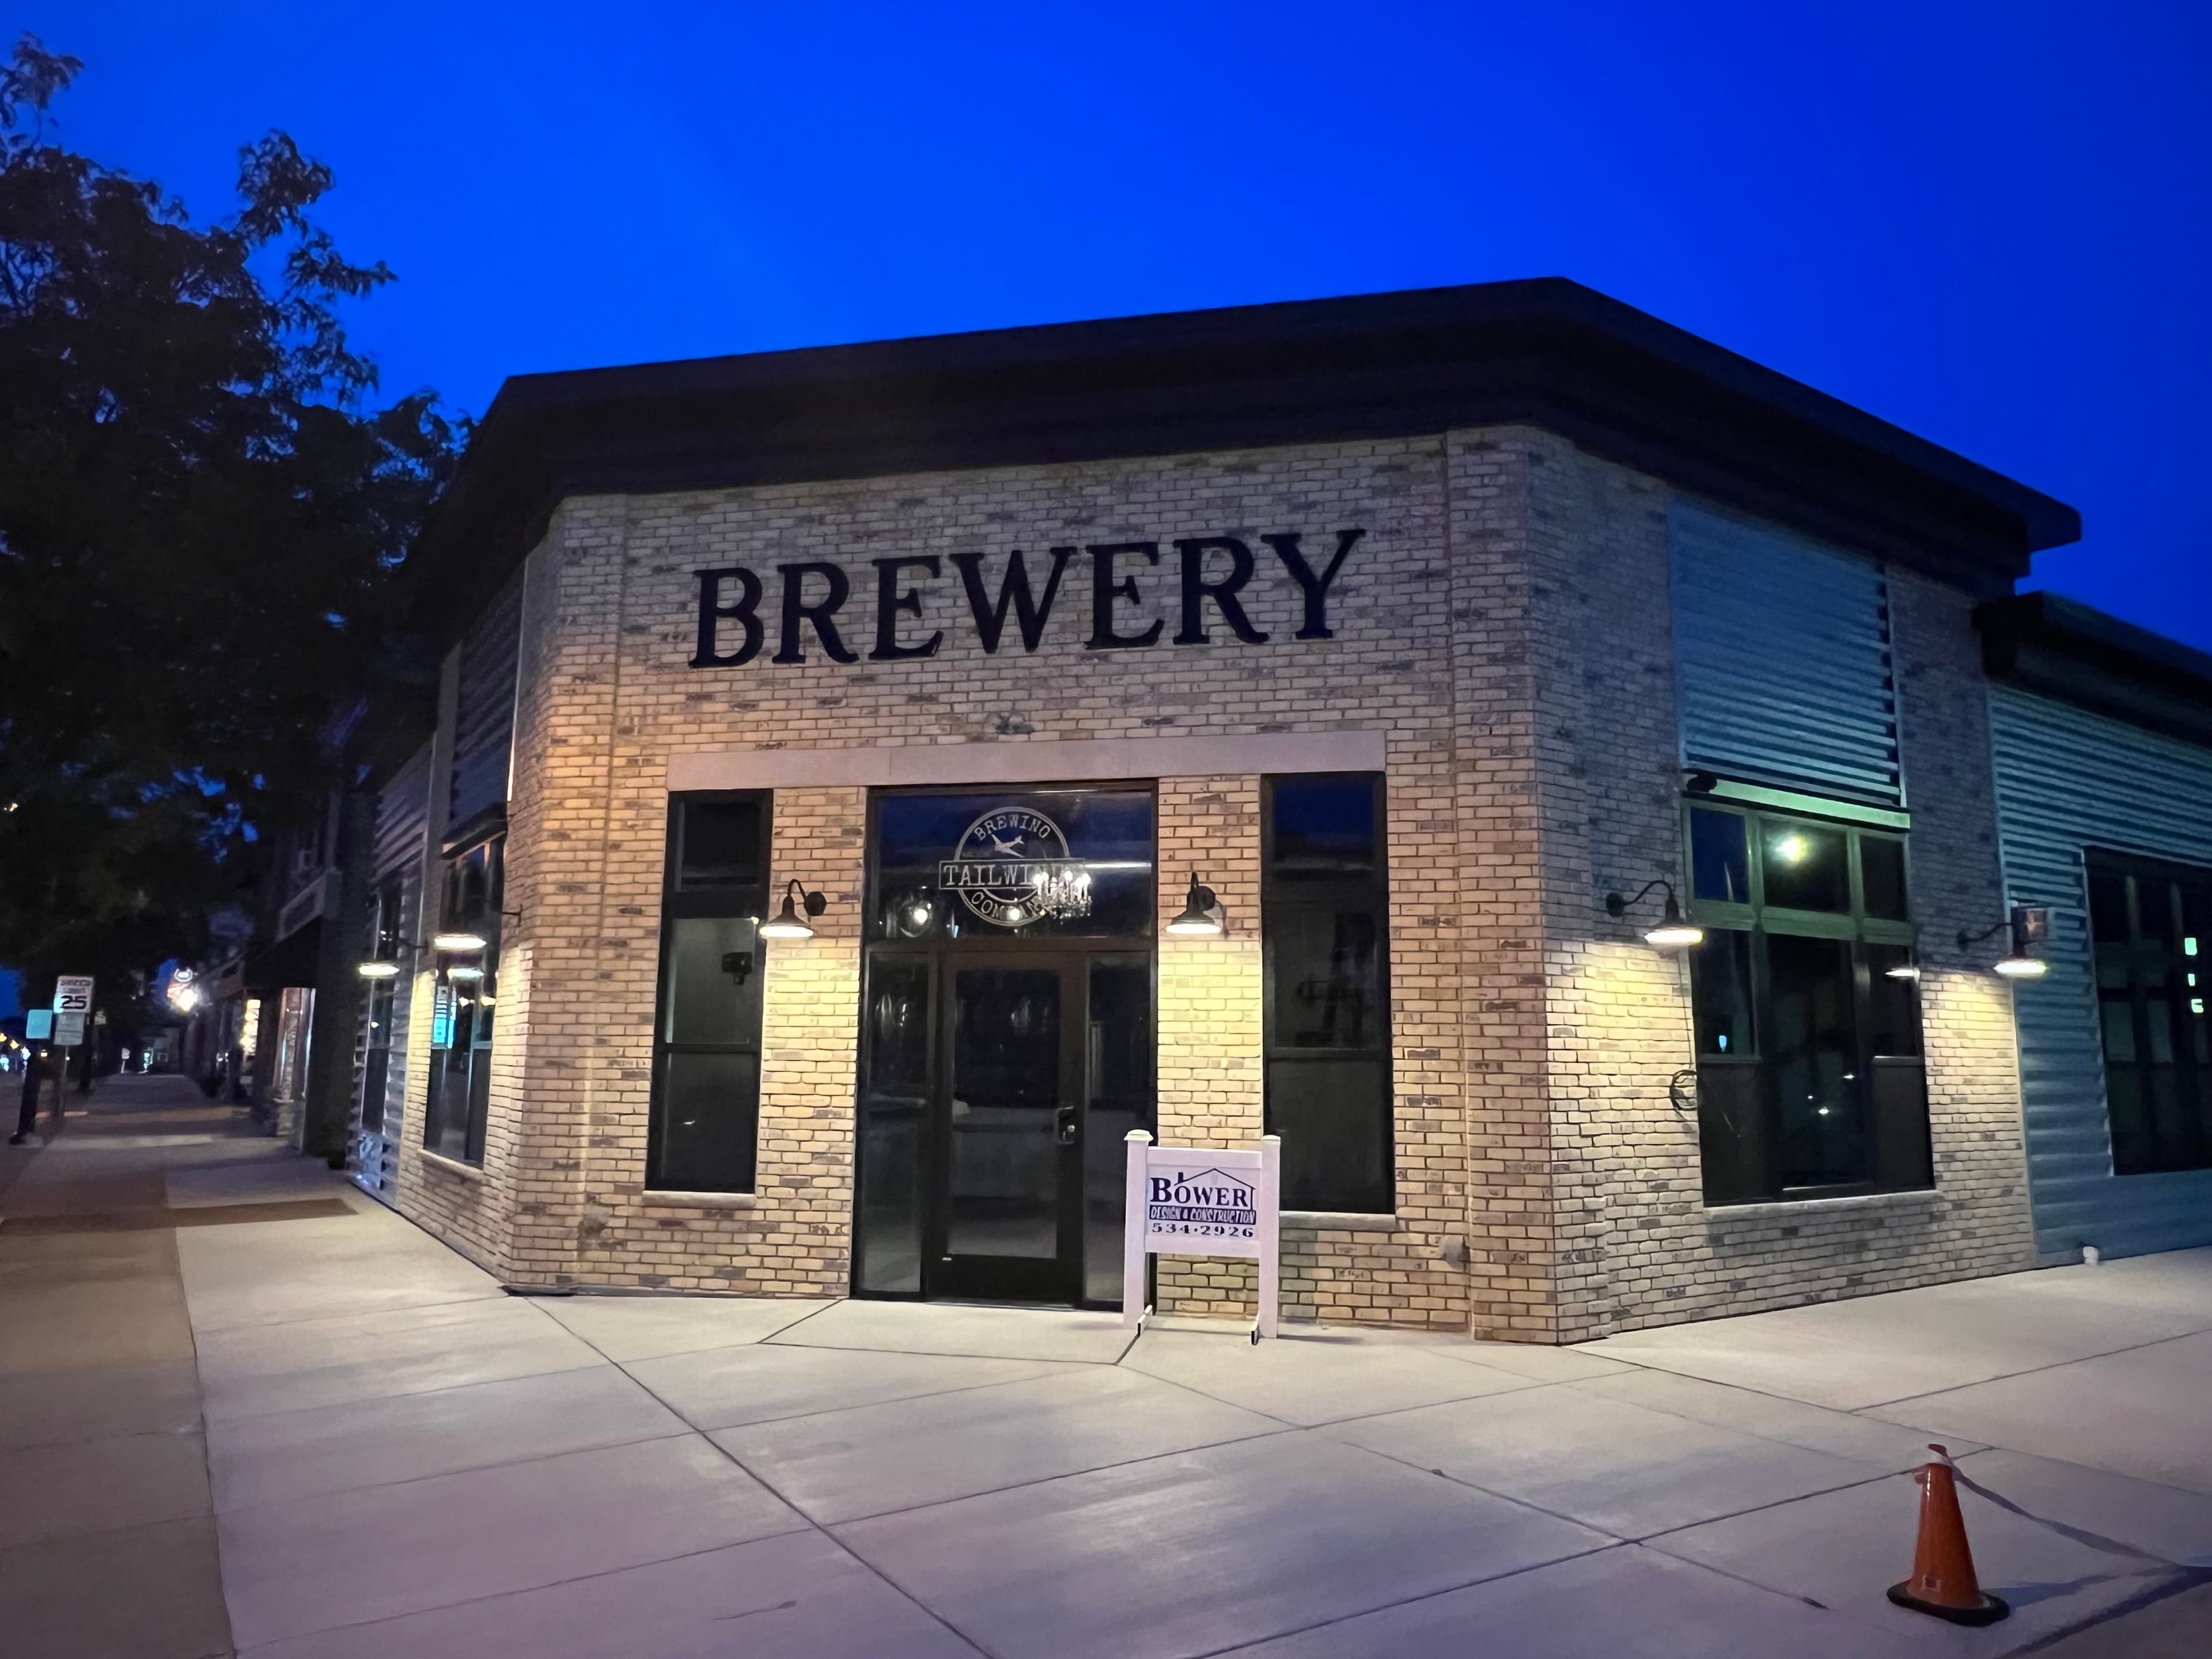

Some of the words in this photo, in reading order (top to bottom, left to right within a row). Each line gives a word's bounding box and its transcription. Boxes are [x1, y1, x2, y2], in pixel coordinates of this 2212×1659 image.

[688, 529, 1366, 668] BREWERY
[60, 995, 87, 1010] 25
[1150, 1177, 1249, 1207] BOWER
[1190, 1208, 1255, 1224] CONSTRUCTION
